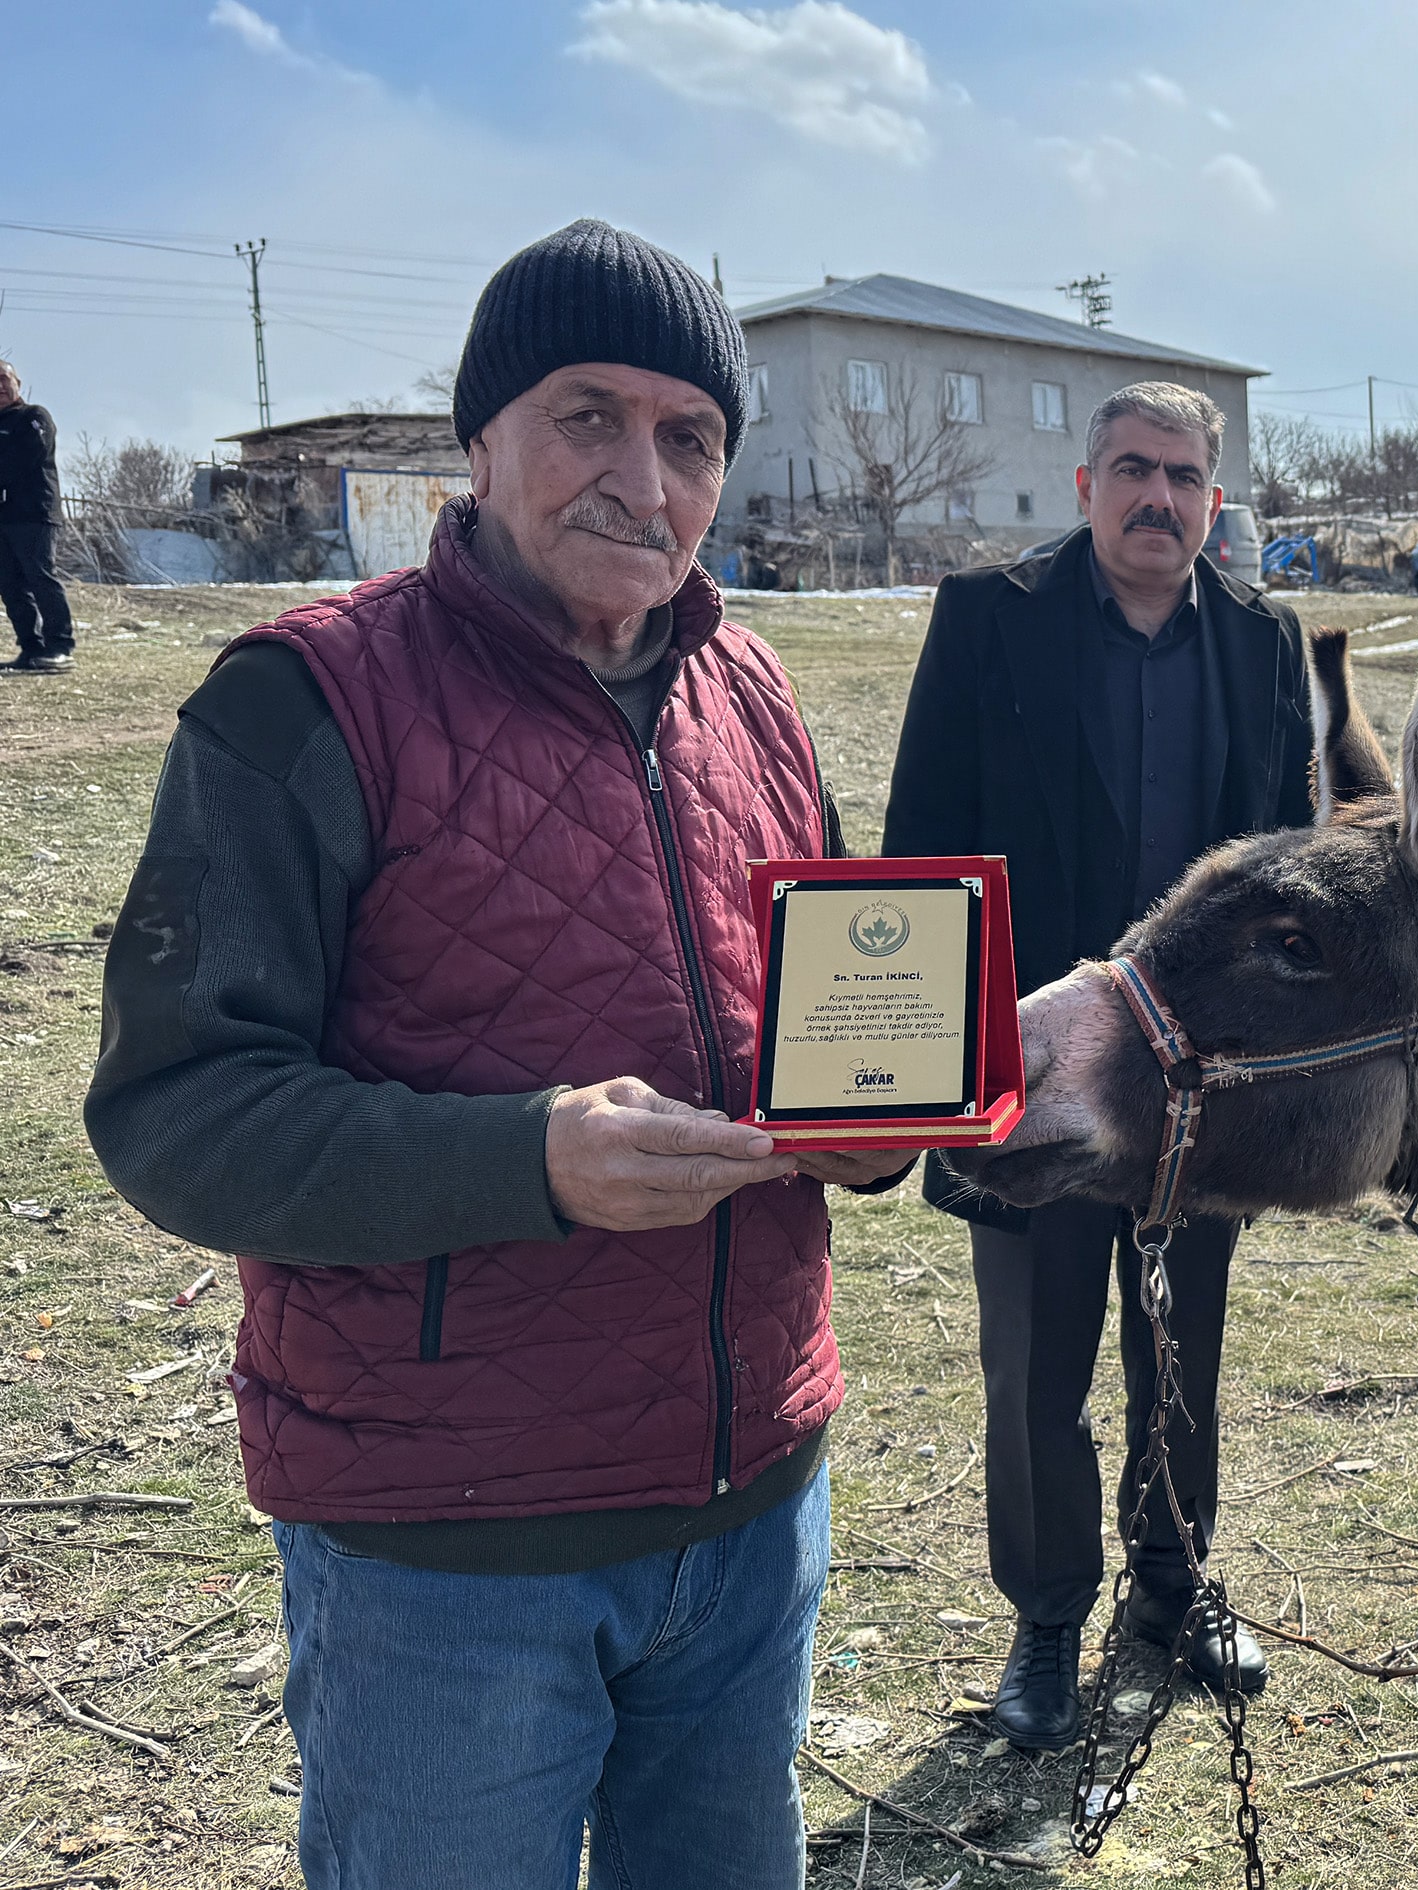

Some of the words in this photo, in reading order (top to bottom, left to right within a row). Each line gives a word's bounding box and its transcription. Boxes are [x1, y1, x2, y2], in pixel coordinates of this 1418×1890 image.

[834, 973, 850, 981] Sn.
[853, 973, 883, 981] Turan
[886, 971, 923, 981] İKİNCİ,
[829, 994, 864, 1002] Kıymetli
[866, 993, 922, 1002] hemşehrimiz,
[814, 1004, 849, 1012] sahipsiz
[852, 1003, 902, 1012] hayvanların
[905, 1002, 933, 1010] bakımı
[804, 1014, 852, 1022] konusunda
[854, 1013, 881, 1021] özveri
[895, 1012, 944, 1021] gayretinizle
[806, 1024, 831, 1032] örnek
[833, 1023, 886, 1033] şahsiyetinizi
[915, 1021, 943, 1030] ediyor,
[891, 1033, 919, 1041] günler
[855, 1073, 895, 1089] ÇAKAR
